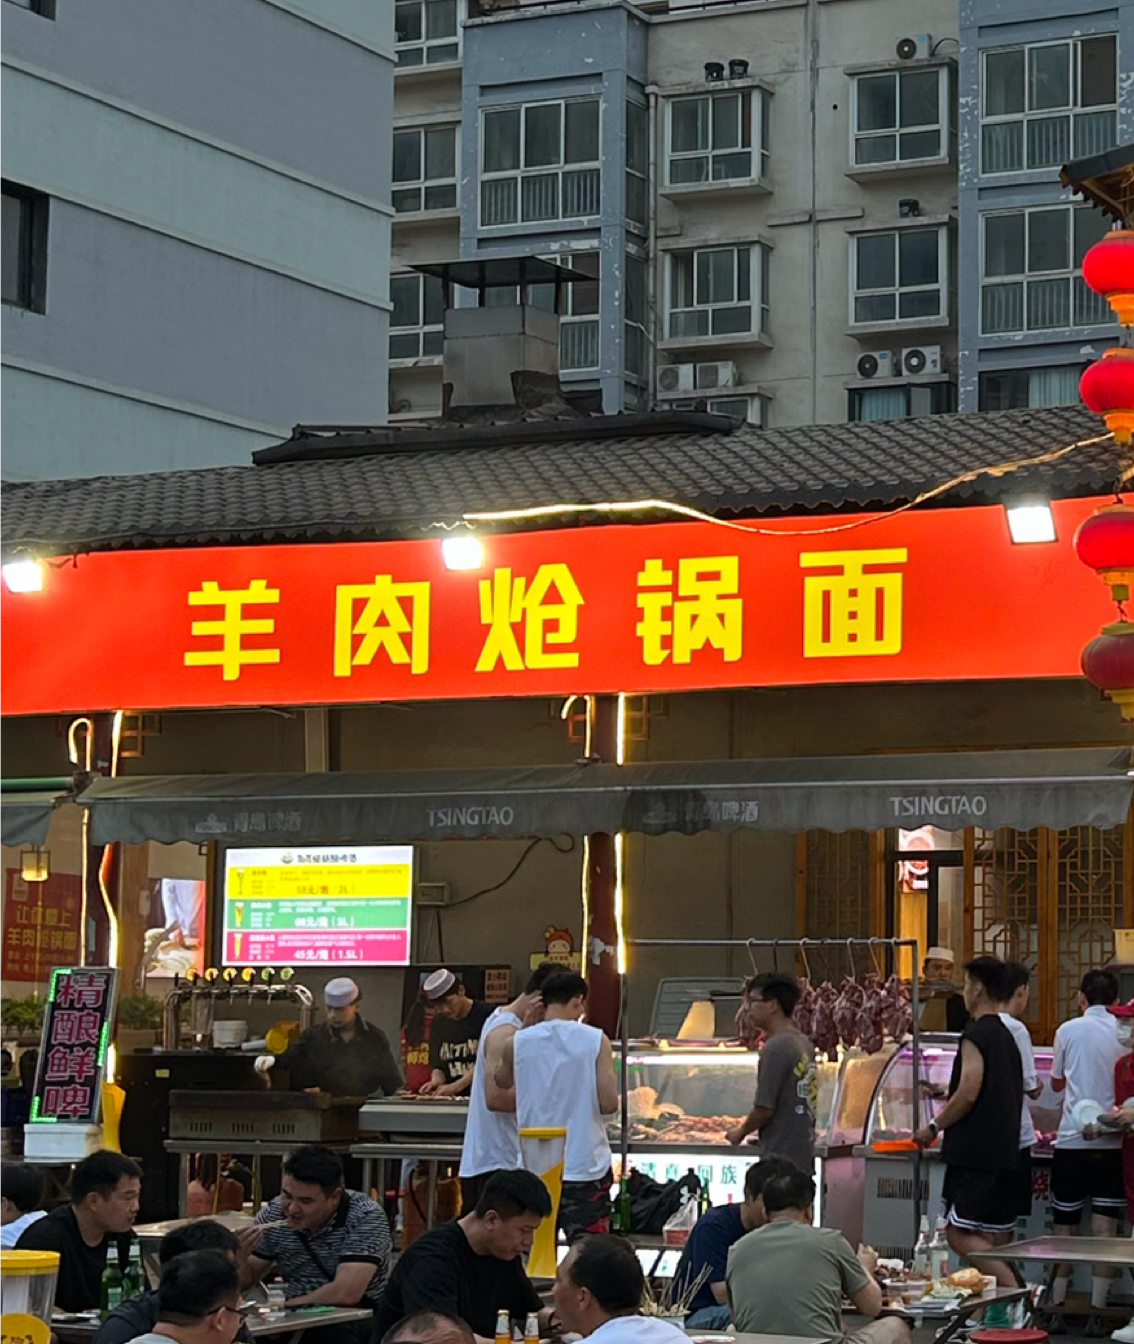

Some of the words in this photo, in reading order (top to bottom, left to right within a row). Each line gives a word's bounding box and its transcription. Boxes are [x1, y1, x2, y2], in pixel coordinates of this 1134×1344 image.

[184, 547, 908, 681] 羊肉炝锅面
[427, 805, 514, 828] TSINGTAO
[889, 795, 988, 817] TSINGTAO
[42, 972, 107, 1120] 精酿鲜啤
